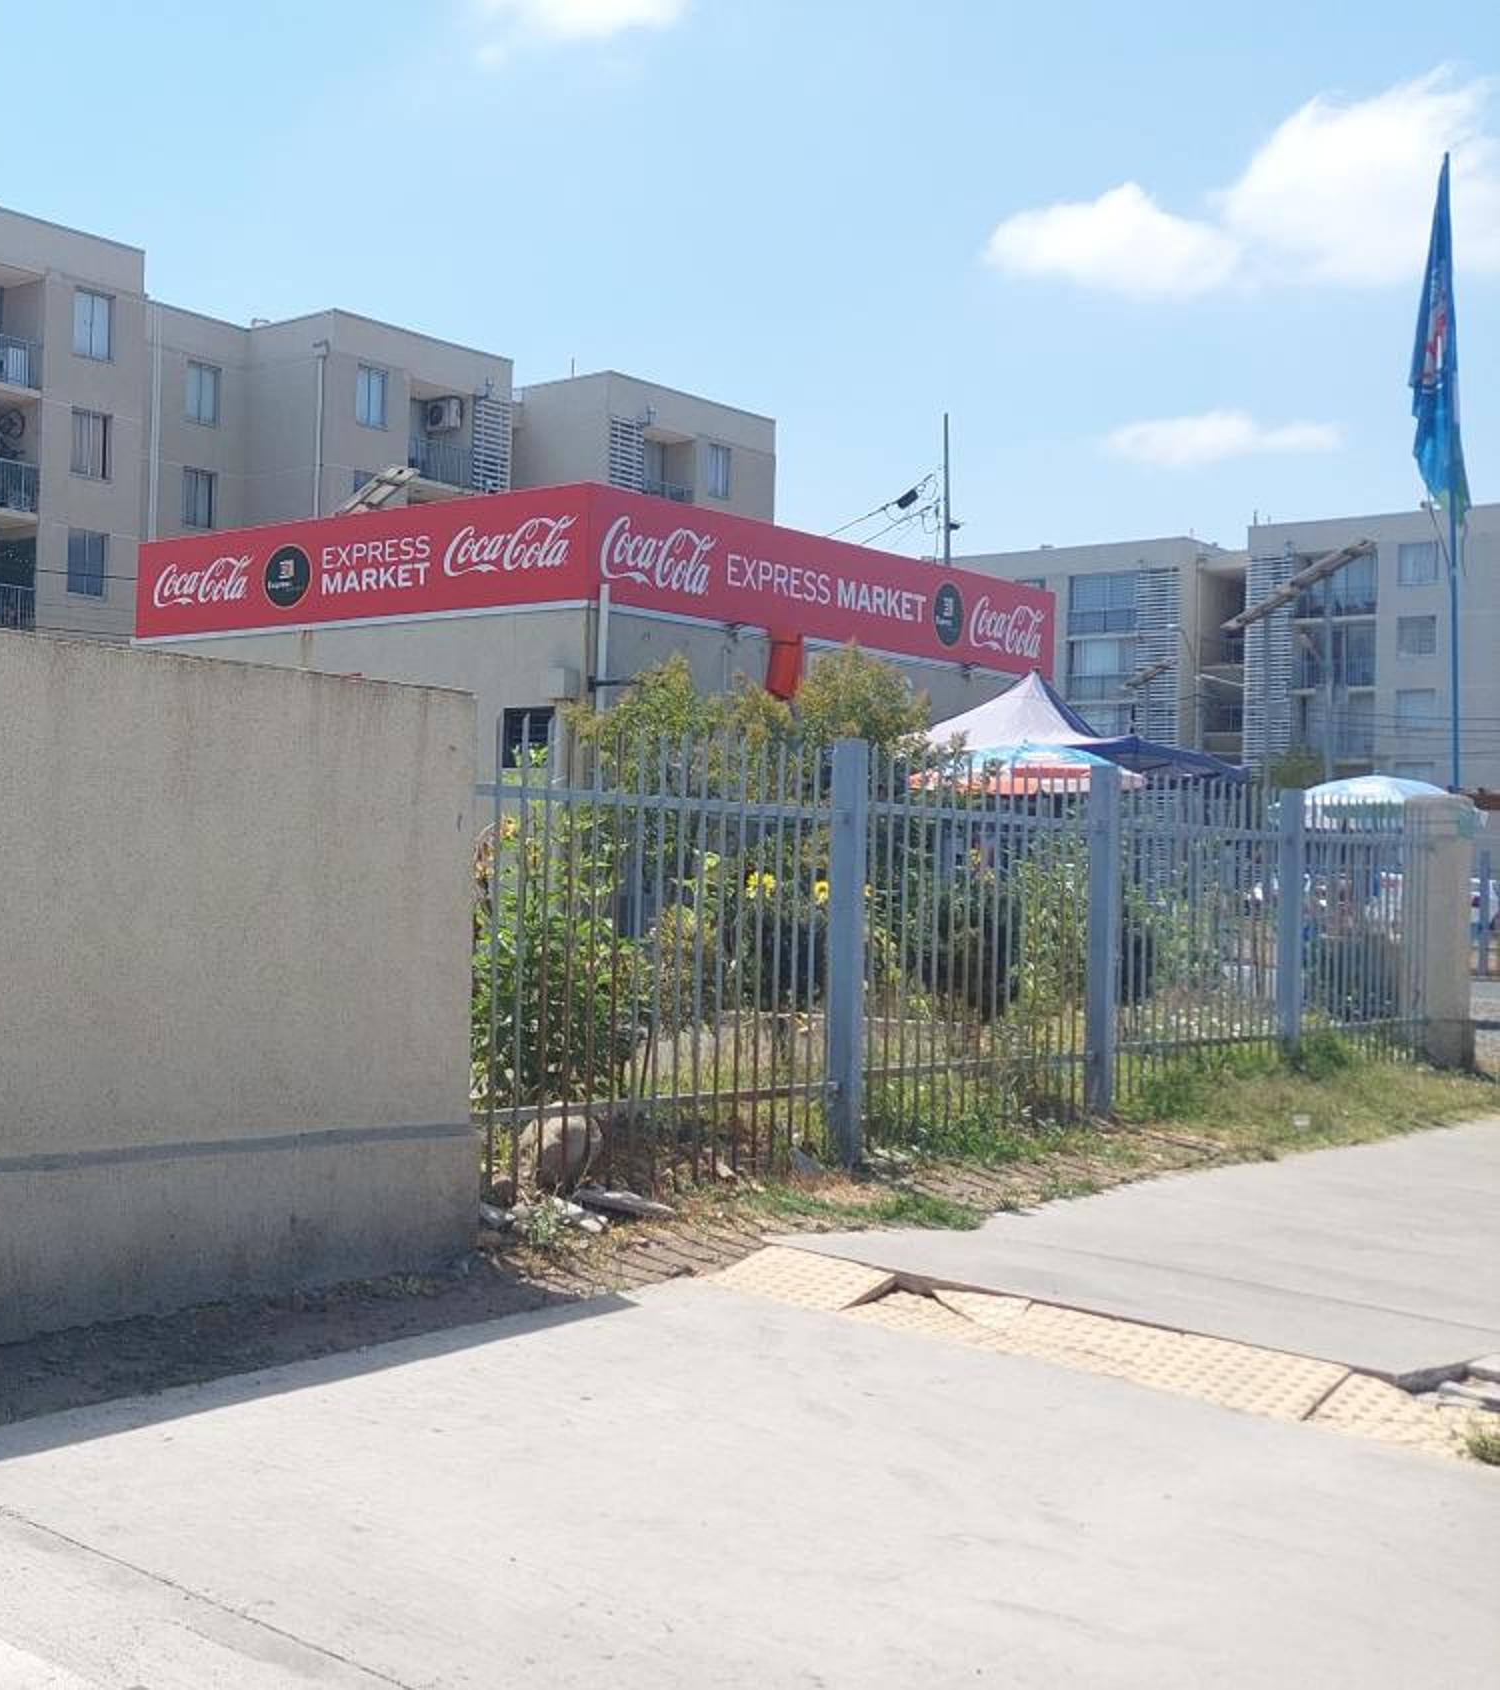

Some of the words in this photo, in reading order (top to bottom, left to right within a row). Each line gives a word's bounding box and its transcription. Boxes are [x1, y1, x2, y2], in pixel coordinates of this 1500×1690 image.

[322, 535, 431, 569] EXPRESS
[443, 514, 579, 577] Coca-Cola
[600, 515, 717, 596] Coca-Cola
[153, 555, 254, 608] Coca-Cola
[321, 562, 431, 595] MARKET
[727, 553, 831, 605] EXPRESS
[836, 578, 927, 623] MARKET
[969, 595, 1045, 659] Coca-Cola
